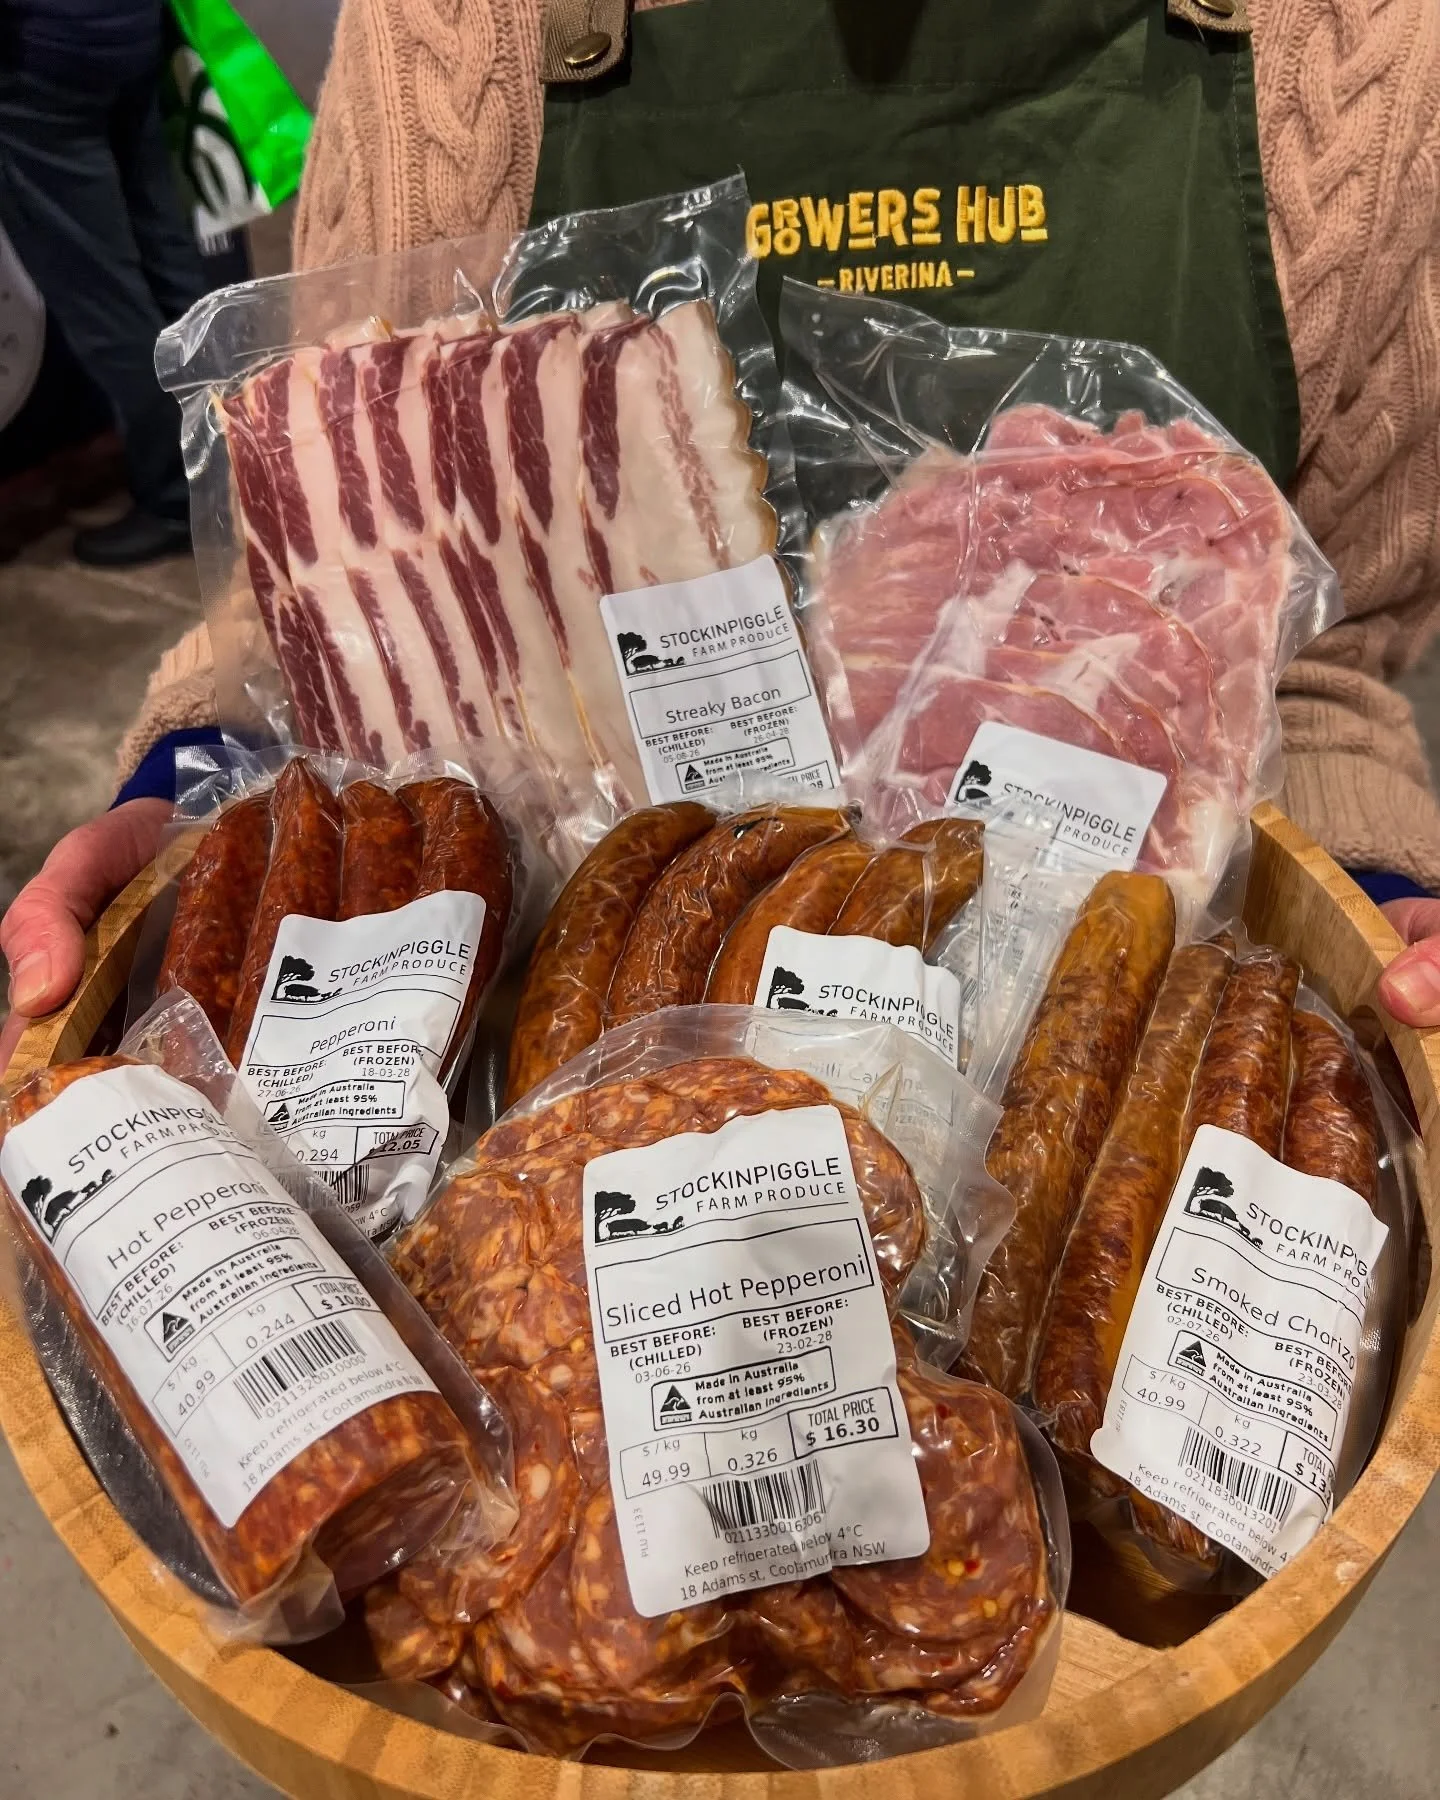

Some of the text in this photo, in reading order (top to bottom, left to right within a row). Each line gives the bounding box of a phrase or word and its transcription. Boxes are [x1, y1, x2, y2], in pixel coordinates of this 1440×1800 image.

[956, 184, 1048, 244] HUB
[839, 260, 954, 292] RIVERINA
[659, 605, 785, 649] STOCKINPIGGLE
[692, 622, 790, 657] FARM PRODUCE
[665, 686, 782, 724] Streaky Bacon
[730, 706, 798, 730] BEST BEFORE:
[645, 727, 713, 747] BEST BEFORE:
[743, 718, 789, 736] (FROZEN)
[658, 738, 705, 755] (CHILLED)
[1064, 825, 1129, 857] PRODUCE
[328, 940, 472, 984] STOCKINPIGGLE
[353, 958, 467, 986] FARM PRODUCE
[309, 1016, 397, 1055] Pepperoni
[850, 1005, 954, 1053] FARM PRODUCE
[342, 1044, 373, 1057] BEST
[353, 1056, 416, 1066] (FROZEN)
[247, 1059, 327, 1078] BEST BEFORE:
[257, 1073, 314, 1088] (CHILLED)
[325, 1095, 350, 1105] least
[353, 1094, 378, 1103] 95%
[330, 1083, 375, 1093] Australia
[291, 1107, 397, 1126] Australian ingredients
[119, 1127, 175, 1159] FARM
[312, 1128, 327, 1139] kg
[296, 1148, 339, 1162] 0.294
[655, 1157, 842, 1210] STOCKINPIGGLE
[696, 1181, 847, 1213] FARM PRODUCE
[106, 1181, 268, 1270] Hot Pepperoni
[208, 1210, 246, 1231] BEST
[1276, 1243, 1328, 1268] FARM
[101, 1242, 184, 1326] BEST BEFORE:
[182, 1275, 212, 1301] Made
[230, 1243, 282, 1270] Australia
[189, 1252, 293, 1312] from at least 95%
[117, 1263, 176, 1325] (CHILLED)
[199, 1280, 259, 1324] Australian
[606, 1253, 866, 1328] Sliced Hot Pepperoni
[1191, 1267, 1281, 1327] Smoked
[247, 1303, 266, 1318] kg
[742, 1298, 849, 1329] BEST BEFORE:
[1156, 1283, 1249, 1337] BEST BEFORE:
[1167, 1302, 1233, 1339] (CHILLED)
[246, 1313, 296, 1350] 0.244
[610, 1326, 716, 1357] BEST BEFORE:
[762, 1315, 834, 1342] (FROZEN)
[776, 1330, 833, 1355] 23-02-28
[1167, 1315, 1220, 1342] 02-07-26
[181, 1355, 198, 1373] kg
[629, 1343, 702, 1371] (CHILLED)
[1275, 1342, 1313, 1359] BEST
[350, 1368, 384, 1386] below
[634, 1361, 692, 1384] 03-06-26
[695, 1361, 799, 1391] Made in Australia
[1169, 1375, 1186, 1391] kg
[1217, 1352, 1312, 1402] Made in Australia
[1289, 1357, 1346, 1401] (FROZEN)
[178, 1370, 216, 1416] 40.99
[696, 1372, 805, 1405] from at least 95%
[699, 1380, 829, 1420] Australian ingredients
[1136, 1387, 1185, 1411] 40.99
[1213, 1362, 1313, 1417] from at least 95%
[808, 1397, 877, 1428] TOTAL PRICE
[1209, 1374, 1329, 1442] Australian ingredients
[1234, 1414, 1251, 1429] kg
[664, 1438, 681, 1452] kg
[740, 1429, 758, 1442] kg
[806, 1416, 881, 1448] $ 16.30
[1215, 1425, 1262, 1457] 0.322
[243, 1475, 258, 1492] 18
[258, 1435, 300, 1474] Adams
[641, 1462, 692, 1488] 49.99
[727, 1447, 778, 1473] 0.326
[1294, 1462, 1304, 1477] $
[1304, 1447, 1327, 1477] TOTAL
[1128, 1471, 1137, 1486] 18
[1143, 1484, 1187, 1513] Adams
[1247, 1526, 1277, 1556] below
[680, 1541, 886, 1601] 18 Adams NSW
